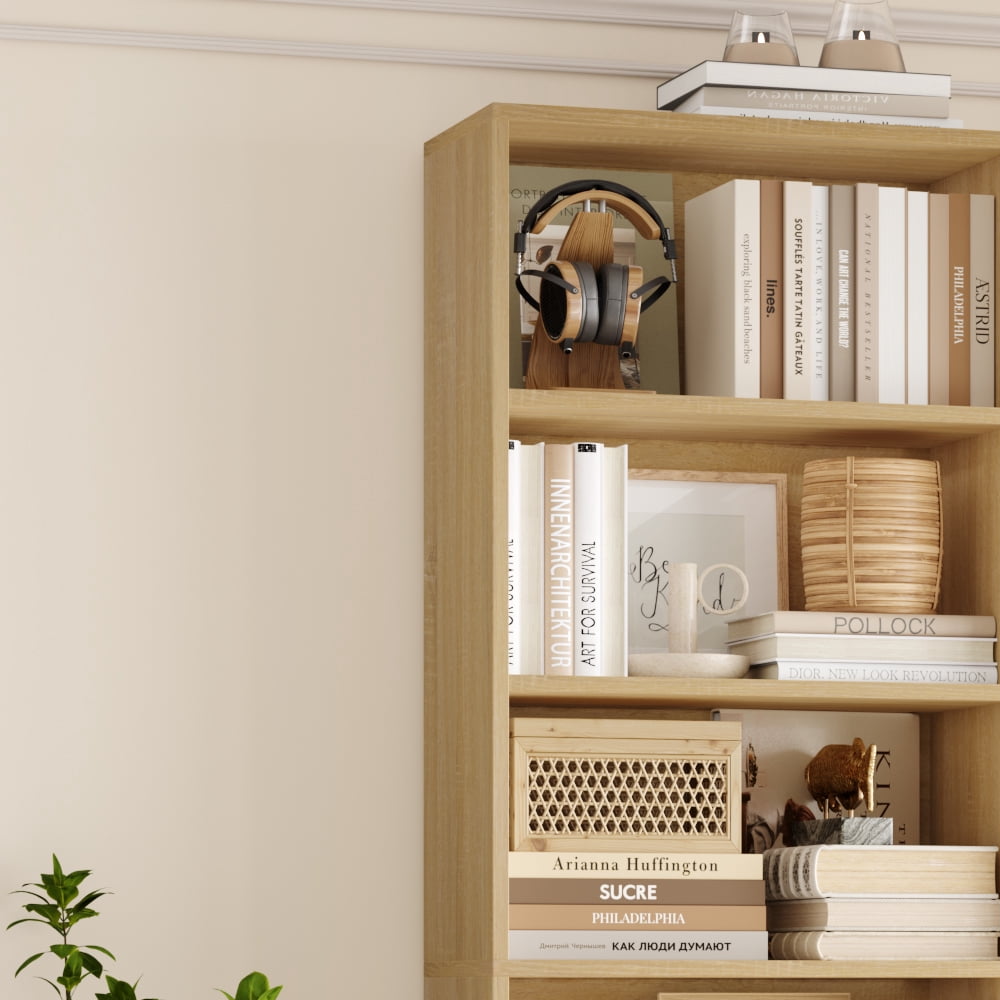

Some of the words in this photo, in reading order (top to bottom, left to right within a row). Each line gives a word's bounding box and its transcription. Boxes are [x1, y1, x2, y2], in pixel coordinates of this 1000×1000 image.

[794, 218, 804, 264] SOUFFLÉS
[864, 213, 872, 283] NATIONAL
[741, 233, 752, 277] exploring
[839, 250, 849, 263] CAN
[795, 268, 803, 297] TARTE
[839, 265, 849, 277] ART
[744, 280, 752, 303] black
[839, 279, 849, 305] CHANGE
[744, 306, 752, 327] sand
[795, 299, 803, 328] TATIN
[839, 308, 849, 319] THE
[954, 267, 964, 344] PHILADELPHIA
[815, 319, 824, 344] AND
[839, 321, 849, 348] WORLD?
[744, 329, 752, 364] beaches
[795, 331, 805, 375] GÂTEAUX
[815, 351, 824, 380] LIFE
[551, 479, 572, 667] INNENARCHITEKTUR
[581, 541, 596, 603] SURVIVAL
[629, 545, 669, 584] Be
[581, 609, 596, 635] FOR
[834, 616, 936, 636] POLLOCK
[581, 641, 595, 667] ART
[789, 667, 824, 680] DIOR.
[829, 667, 859, 681] NEW
[862, 668, 899, 681] LOOK
[903, 669, 987, 683] REVOLUTION
[552, 856, 619, 871] Arianna
[627, 857, 719, 876] Huffington
[600, 884, 657, 900] SUCRE
[592, 913, 685, 924] PHILADELPHIA
[612, 942, 635, 951] КАК
[639, 942, 676, 952] ЛЮДИ
[678, 942, 731, 952] ДУМАЮТ
